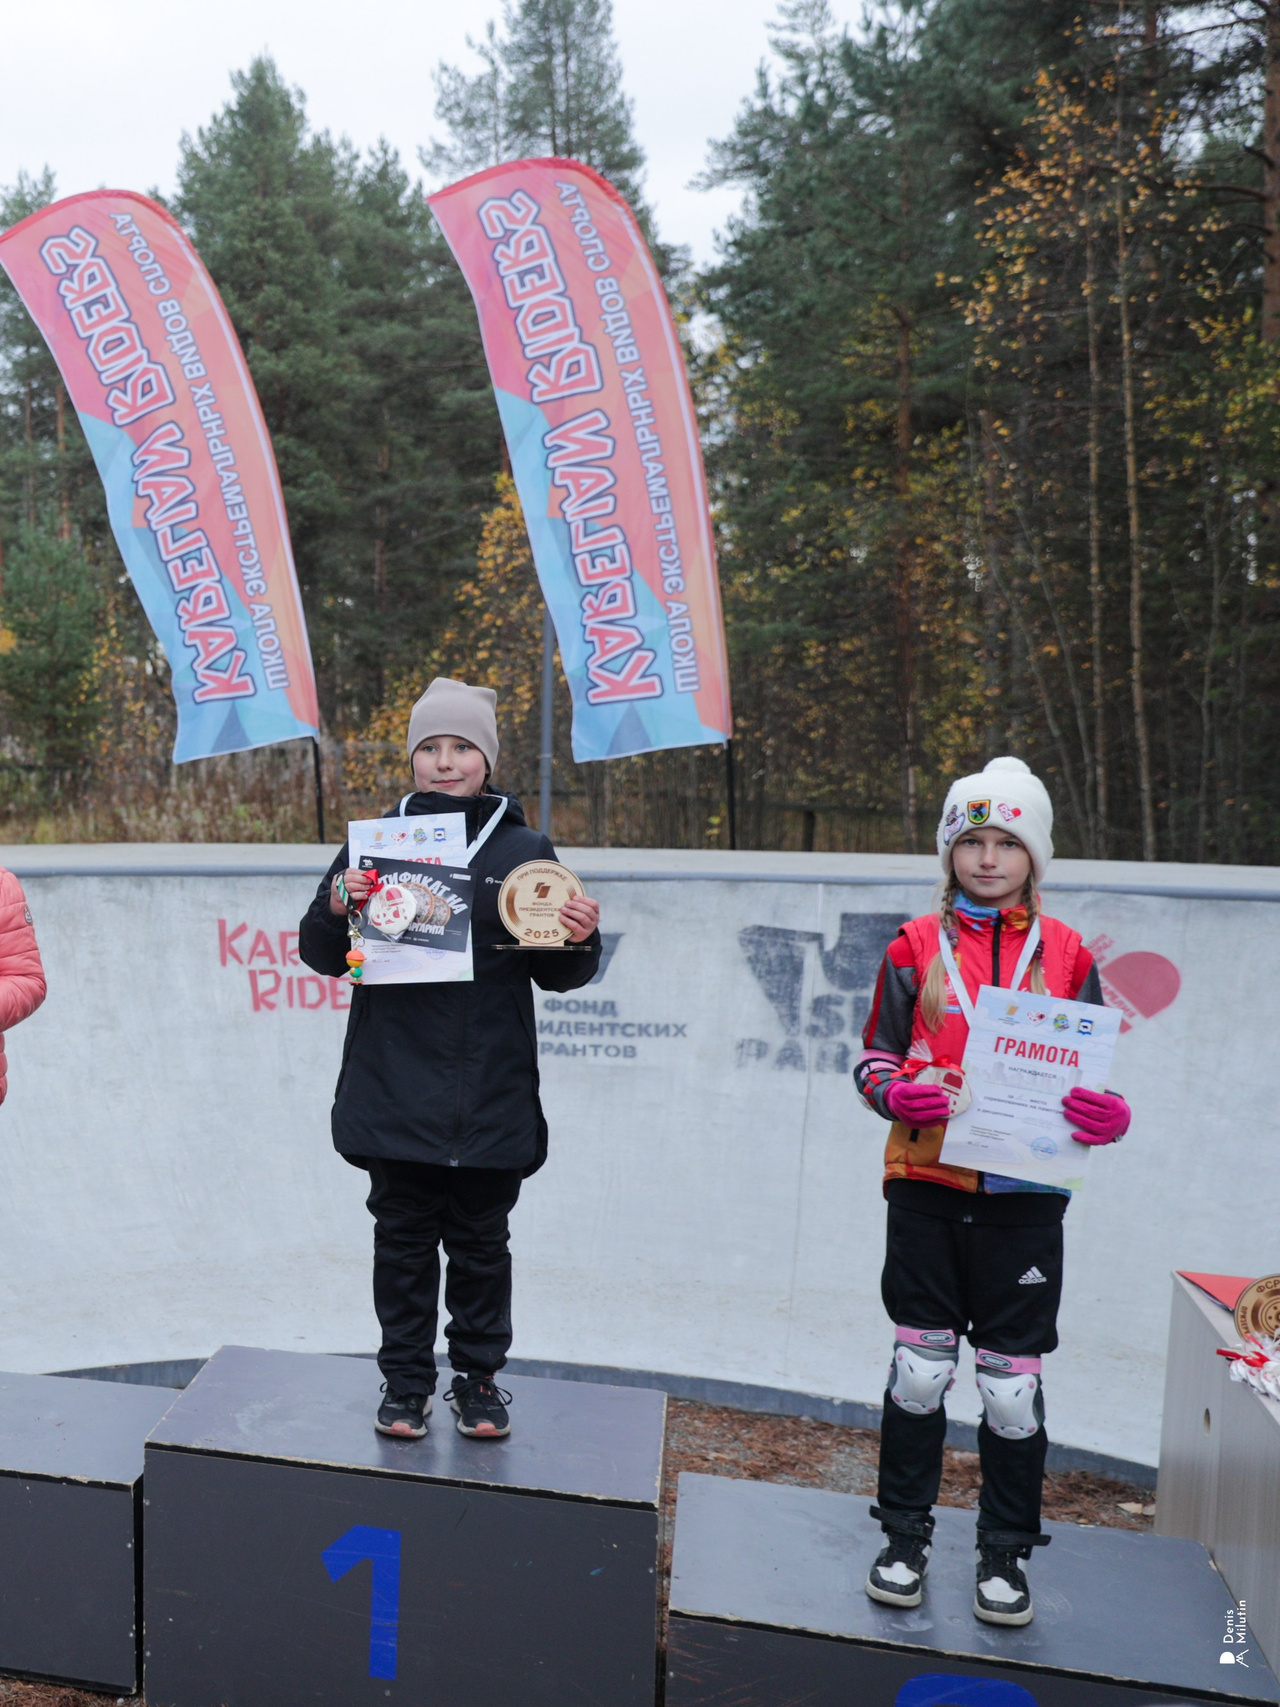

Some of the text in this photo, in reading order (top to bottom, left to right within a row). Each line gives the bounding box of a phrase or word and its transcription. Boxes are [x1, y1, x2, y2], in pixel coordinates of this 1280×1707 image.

[517, 868, 568, 881] ПРИ ПОДДЕРЖКЕ
[379, 871, 469, 915] ТИФИКАТ НА
[407, 922, 445, 935] АРГАРИТА
[524, 928, 560, 939] 2025
[248, 969, 352, 1012] RIDE
[543, 998, 618, 1017] ФОНД
[537, 1020, 687, 1037] ИДЕНТСКИХ
[538, 1042, 637, 1058] РАНТОВ
[993, 1036, 1079, 1067] ГРАМОТА
[1008, 1066, 1057, 1079] НАГРАЖДАЕТСЯ
[1018, 1276, 1047, 1284] adidas
[320, 1524, 401, 1681] 1
